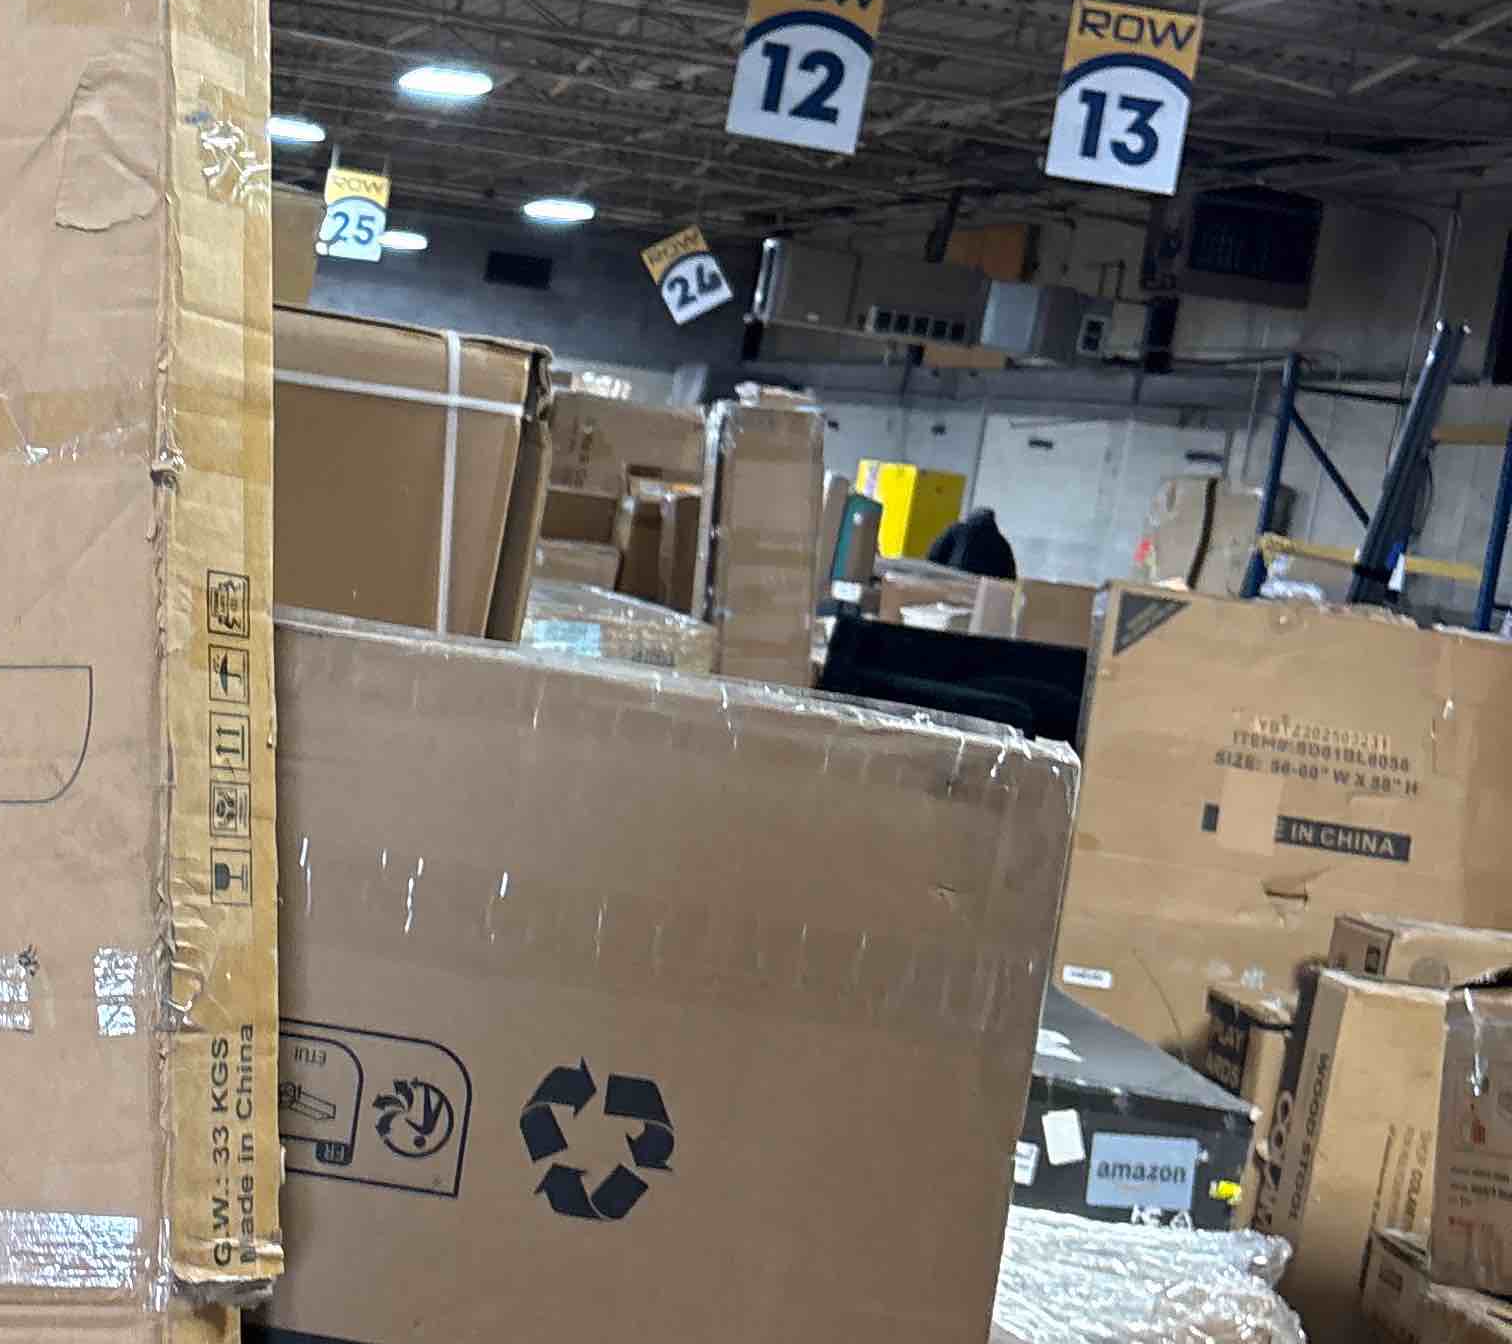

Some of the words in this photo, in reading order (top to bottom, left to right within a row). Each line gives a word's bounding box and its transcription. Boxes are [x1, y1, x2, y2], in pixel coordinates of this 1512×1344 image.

[1078, 8, 1196, 51] ROW
[760, 41, 846, 124] 12
[1078, 89, 1165, 166] 13
[331, 210, 376, 246] 25
[666, 262, 723, 312] 24
[1290, 822, 1314, 844] IN
[1319, 826, 1395, 855] CHINA
[210, 1036, 231, 1114] KGS
[235, 1023, 256, 1122] China
[212, 1123, 231, 1160] 33
[236, 1132, 256, 1163] in
[1096, 1158, 1187, 1184] amazon
